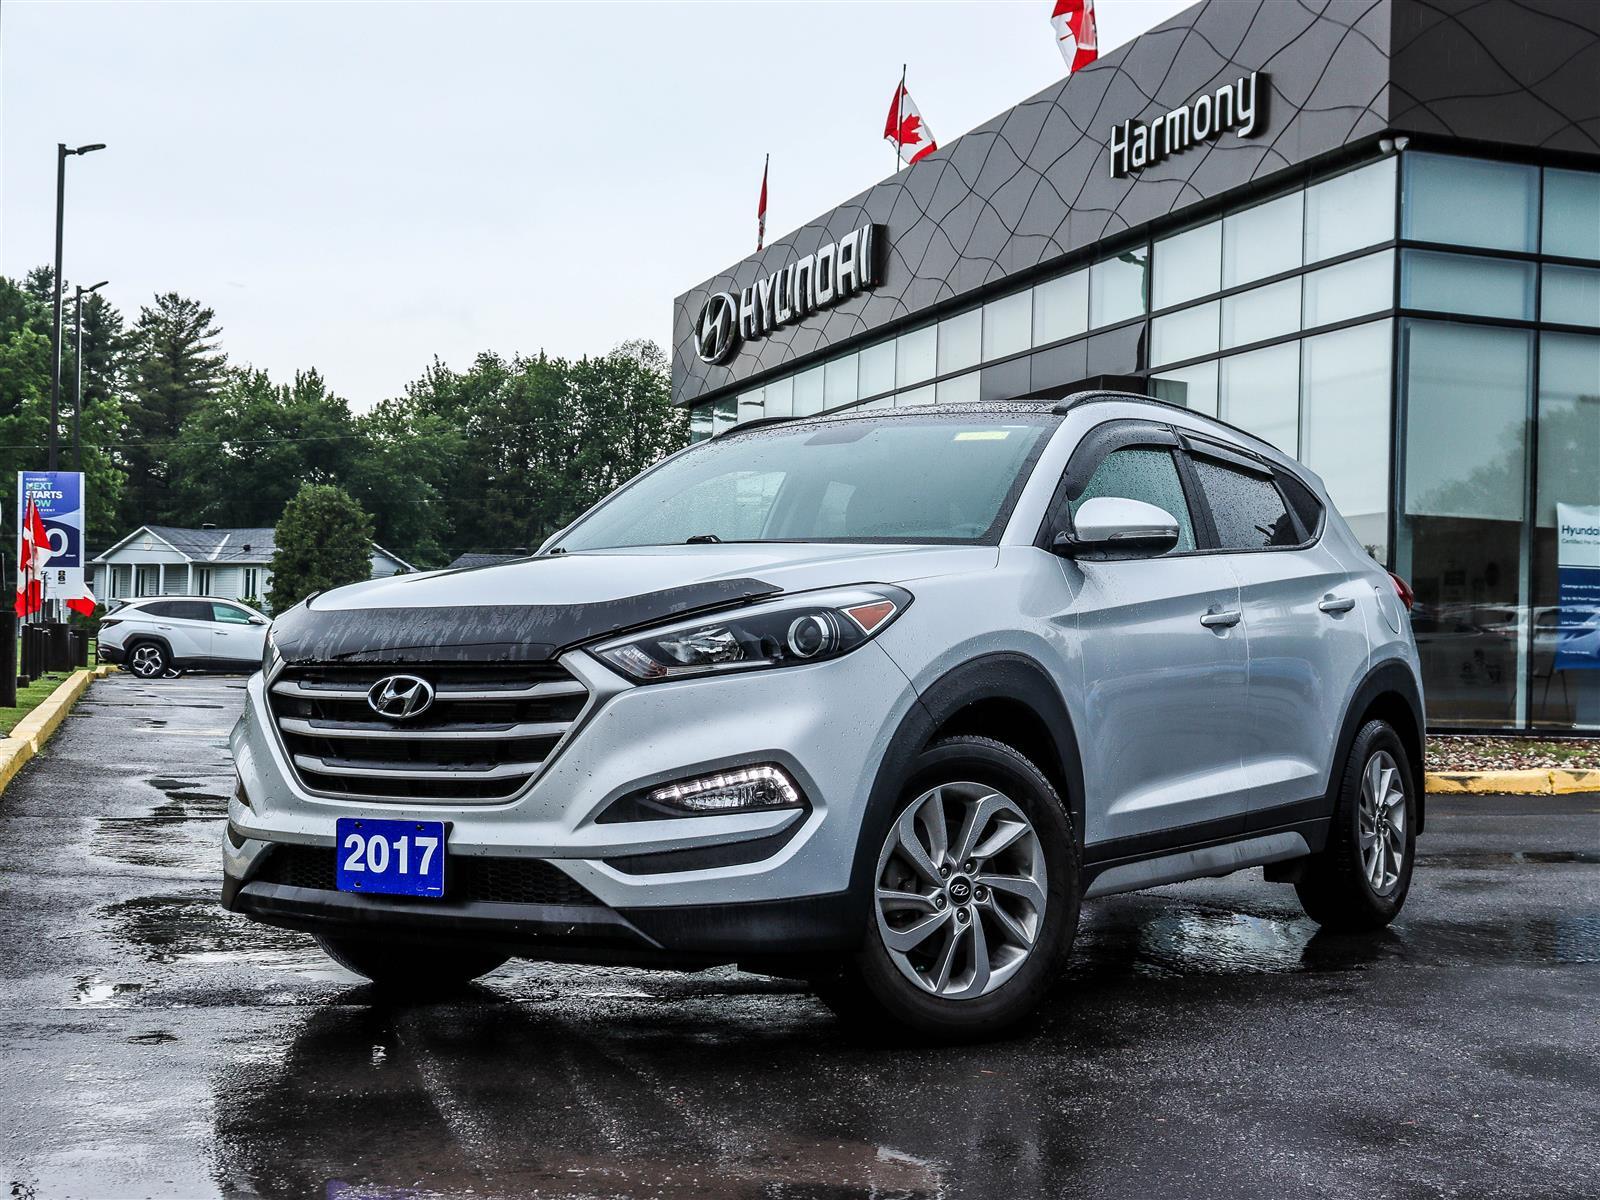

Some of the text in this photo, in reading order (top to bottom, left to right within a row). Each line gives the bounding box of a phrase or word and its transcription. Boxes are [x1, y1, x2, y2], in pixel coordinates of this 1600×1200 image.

[1110, 71, 1257, 178] Harmony
[740, 223, 873, 341] HYUNDAI
[25, 490, 63, 499] STARTS
[343, 833, 438, 875] 2017
